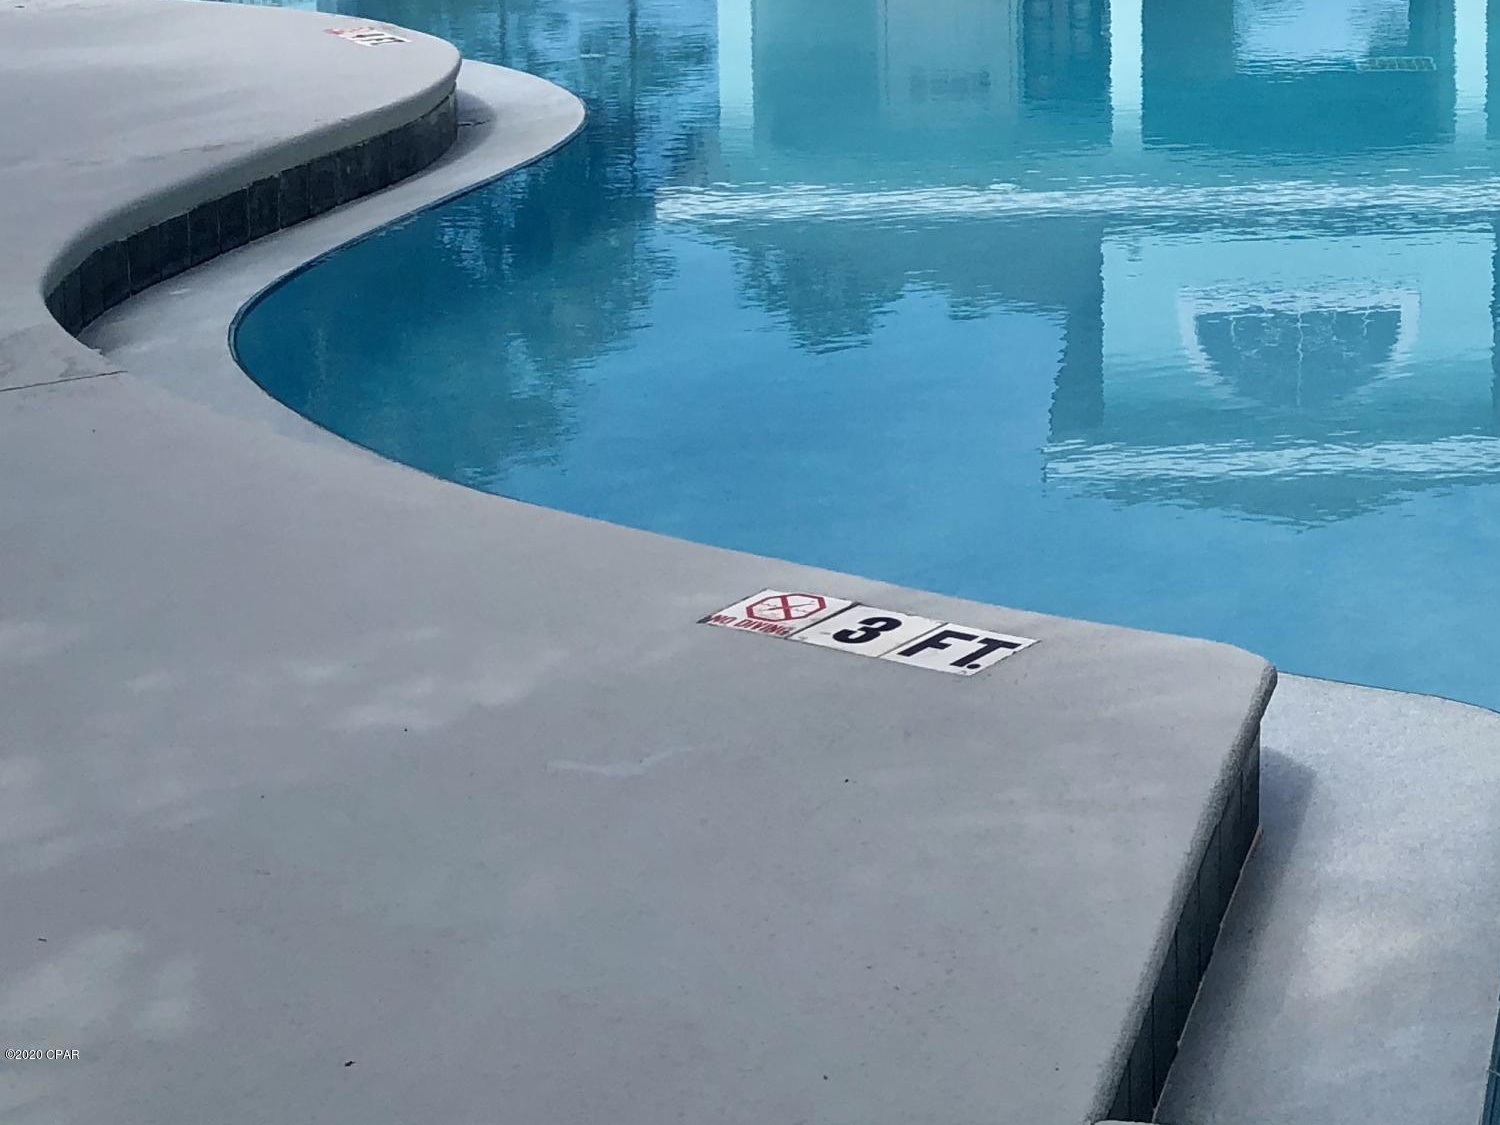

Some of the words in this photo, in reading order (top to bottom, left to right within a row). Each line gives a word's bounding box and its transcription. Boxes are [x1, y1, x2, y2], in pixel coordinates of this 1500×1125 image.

[711, 614, 737, 624] NO
[734, 619, 794, 636] DIVING
[832, 616, 903, 644] 3
[897, 629, 1022, 669] FT.
